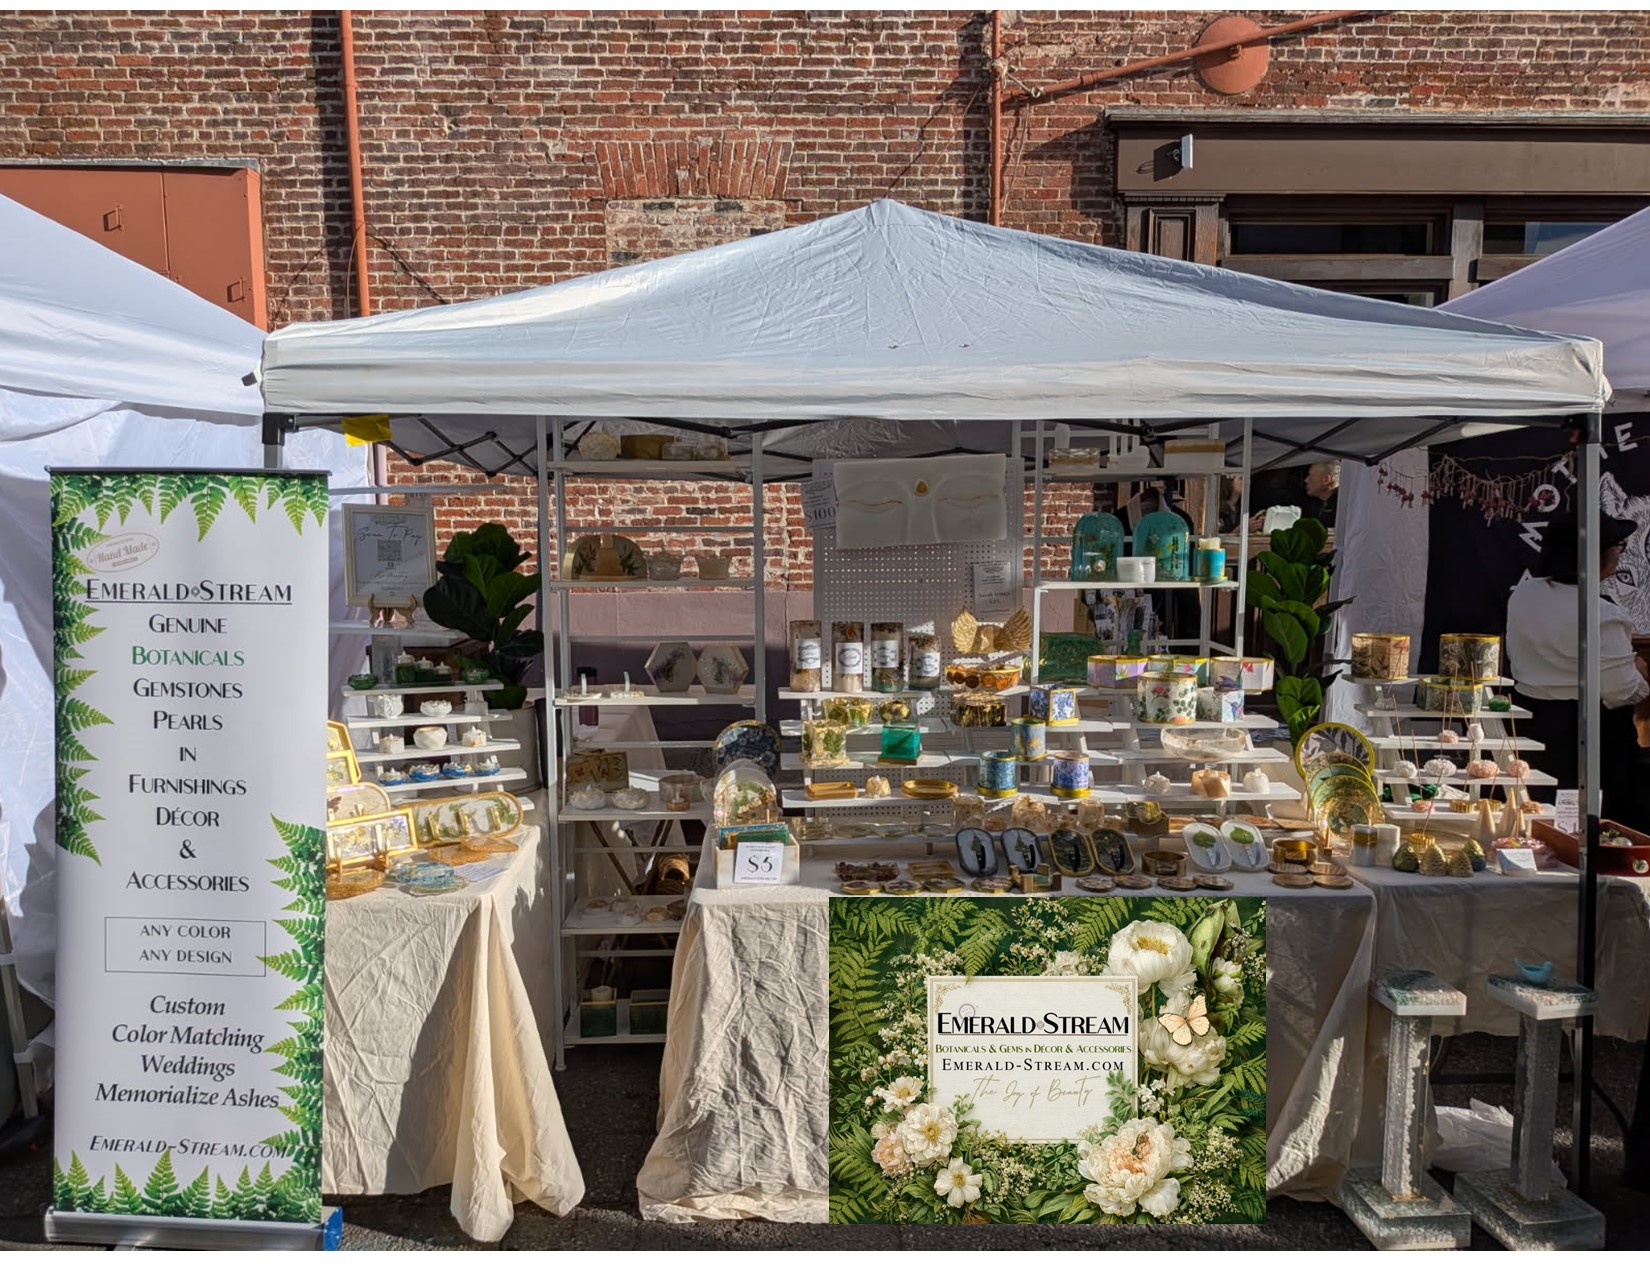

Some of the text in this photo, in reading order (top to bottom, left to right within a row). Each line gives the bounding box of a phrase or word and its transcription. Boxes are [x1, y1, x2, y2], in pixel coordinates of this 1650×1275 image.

[96, 547, 122, 563] Hand
[86, 579, 291, 602] EMERALD STREAM
[149, 614, 226, 634] GENUINE
[132, 645, 244, 666] BOTANICALS
[133, 678, 243, 698] GEMSTONES
[153, 710, 223, 731] PEARLS
[179, 746, 196, 761] IN
[129, 774, 247, 795] FURNISHINGS
[156, 806, 220, 827] DÉCOR
[179, 839, 196, 859] &
[747, 851, 773, 873] $5
[126, 871, 249, 892] ACCESSORIES
[141, 925, 231, 939] ANY COLOR
[139, 949, 232, 964] ANY DESIGN
[149, 995, 226, 1016] Custom
[938, 1012, 1129, 1035] EMERALD STREAM
[112, 1024, 265, 1053] Color Matching
[935, 1044, 986, 1054] BOTANICALS
[989, 1045, 996, 1053] &
[999, 1044, 1023, 1053] GEMS
[1034, 1043, 1063, 1054] DÉCOR
[1066, 1045, 1073, 1053] &
[1076, 1045, 1131, 1054] ACCESSORIES
[141, 1054, 235, 1081] Weddings
[95, 1083, 280, 1110] Memorialize Ashes
[970, 1074, 1101, 1109] The Joy of Beauty
